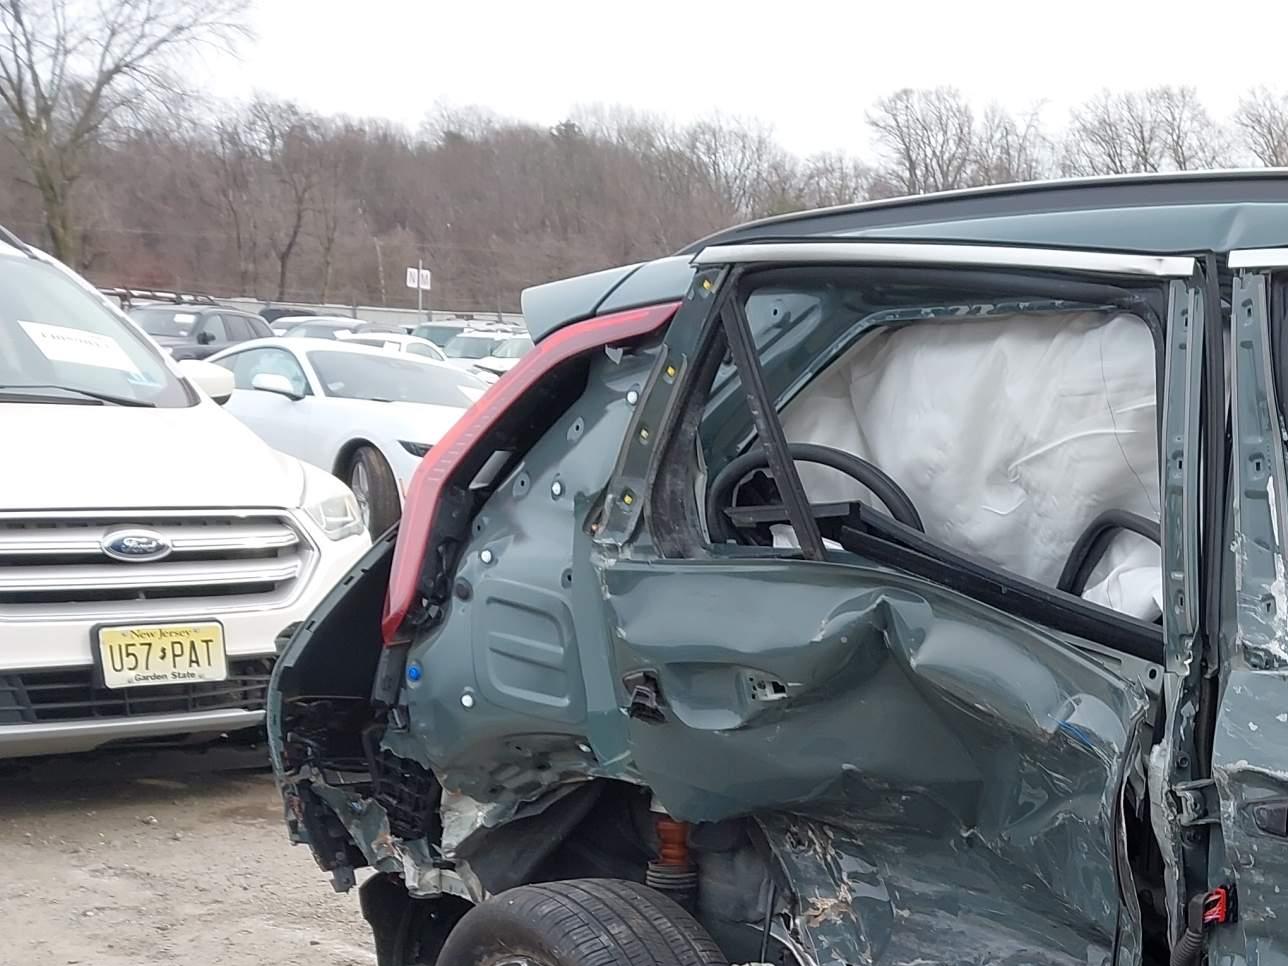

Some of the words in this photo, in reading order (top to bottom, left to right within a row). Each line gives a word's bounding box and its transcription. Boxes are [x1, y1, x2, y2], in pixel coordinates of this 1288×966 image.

[121, 536, 158, 553] Ford
[130, 629, 155, 639] New
[158, 628, 193, 640] Jersey
[109, 642, 153, 672] U57
[171, 639, 214, 669] PAT
[134, 672, 168, 682] Garden
[171, 671, 196, 680] State
